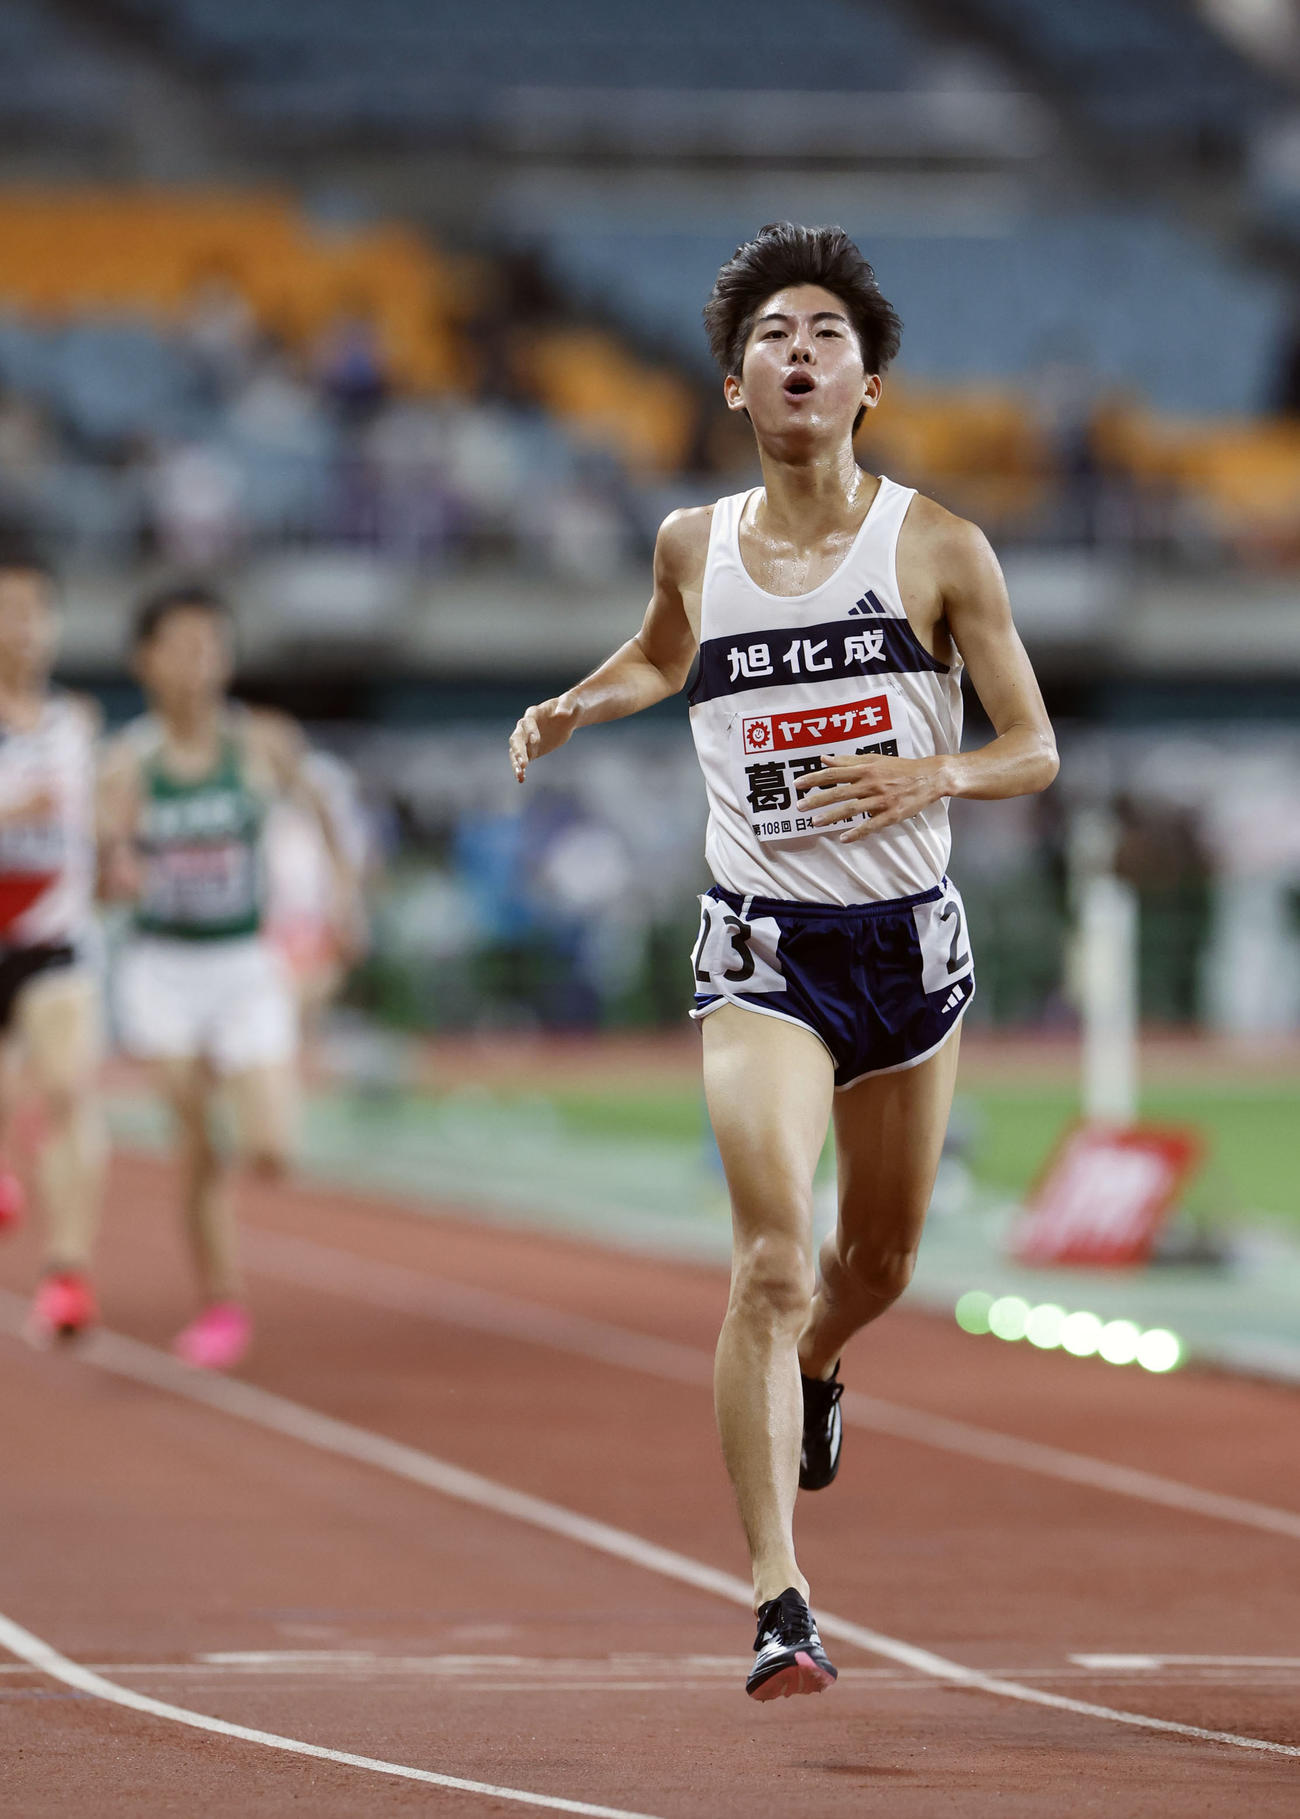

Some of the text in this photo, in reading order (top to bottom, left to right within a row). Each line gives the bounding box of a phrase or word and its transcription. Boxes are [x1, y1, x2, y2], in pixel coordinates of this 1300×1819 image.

[727, 629, 887, 683] 旭化成
[778, 706, 882, 742] ヤマザキ
